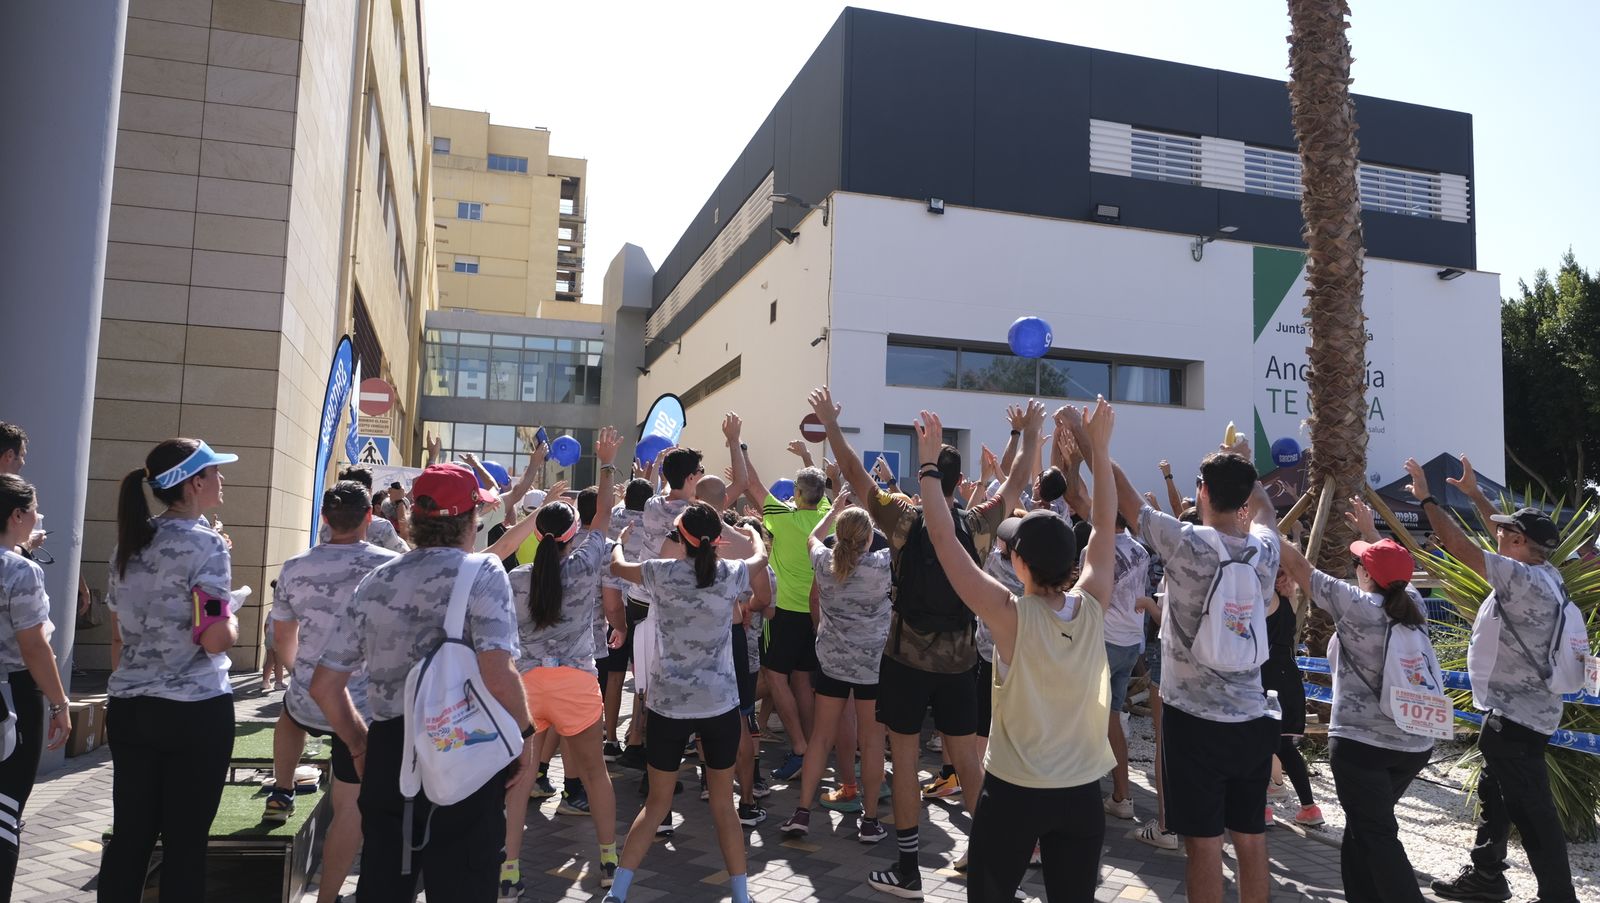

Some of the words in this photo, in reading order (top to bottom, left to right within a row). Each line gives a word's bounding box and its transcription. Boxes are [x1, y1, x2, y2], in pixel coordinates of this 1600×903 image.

[1275, 322, 1306, 335] Junta
[1266, 388, 1298, 415] TE
[1399, 702, 1447, 723] 1075
